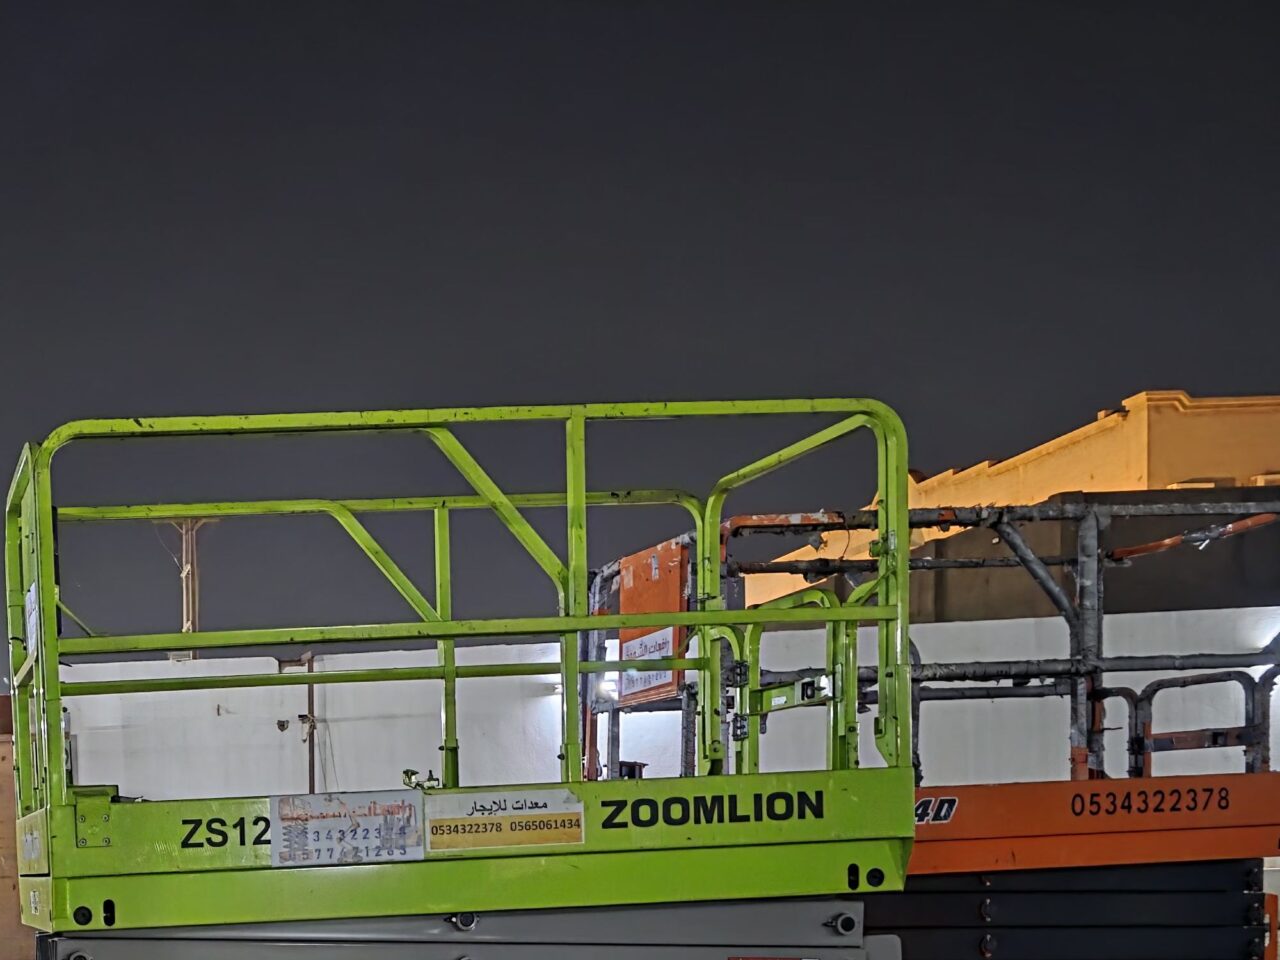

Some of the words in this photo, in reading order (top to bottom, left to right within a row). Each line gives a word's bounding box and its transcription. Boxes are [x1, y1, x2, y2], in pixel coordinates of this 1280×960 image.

[511, 800, 548, 811] معدات
[600, 790, 825, 830] ZOOMLION
[1071, 787, 1230, 816] 0534322378
[180, 816, 271, 849] ZS12
[431, 822, 502, 836] 0534322378
[509, 818, 581, 832] 0565061434
